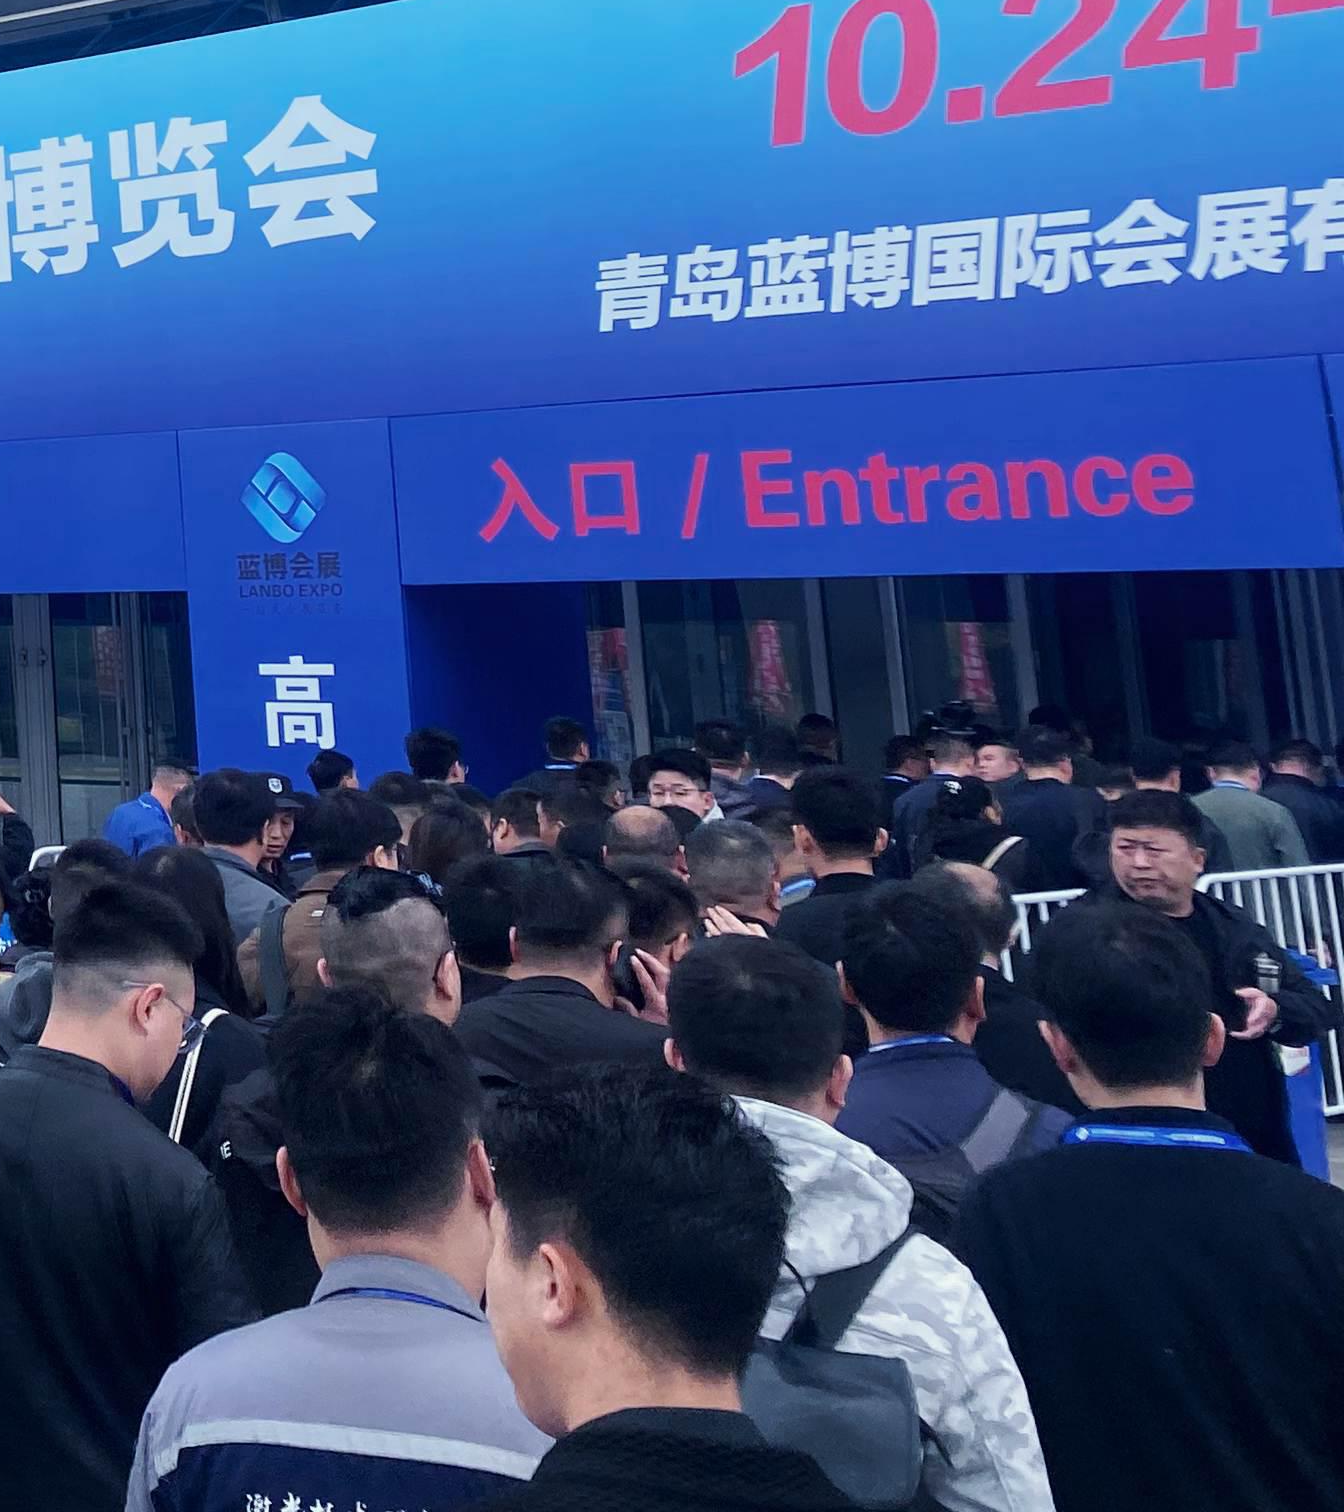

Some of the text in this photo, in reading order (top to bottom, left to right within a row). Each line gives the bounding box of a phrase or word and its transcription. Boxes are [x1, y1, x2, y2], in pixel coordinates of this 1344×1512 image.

[480, 457, 641, 544] 入口
[740, 447, 1195, 531] Entrance
[237, 552, 343, 581] 蓝博会展
[239, 583, 343, 599] LANBO EXPO
[258, 654, 336, 751] 高
